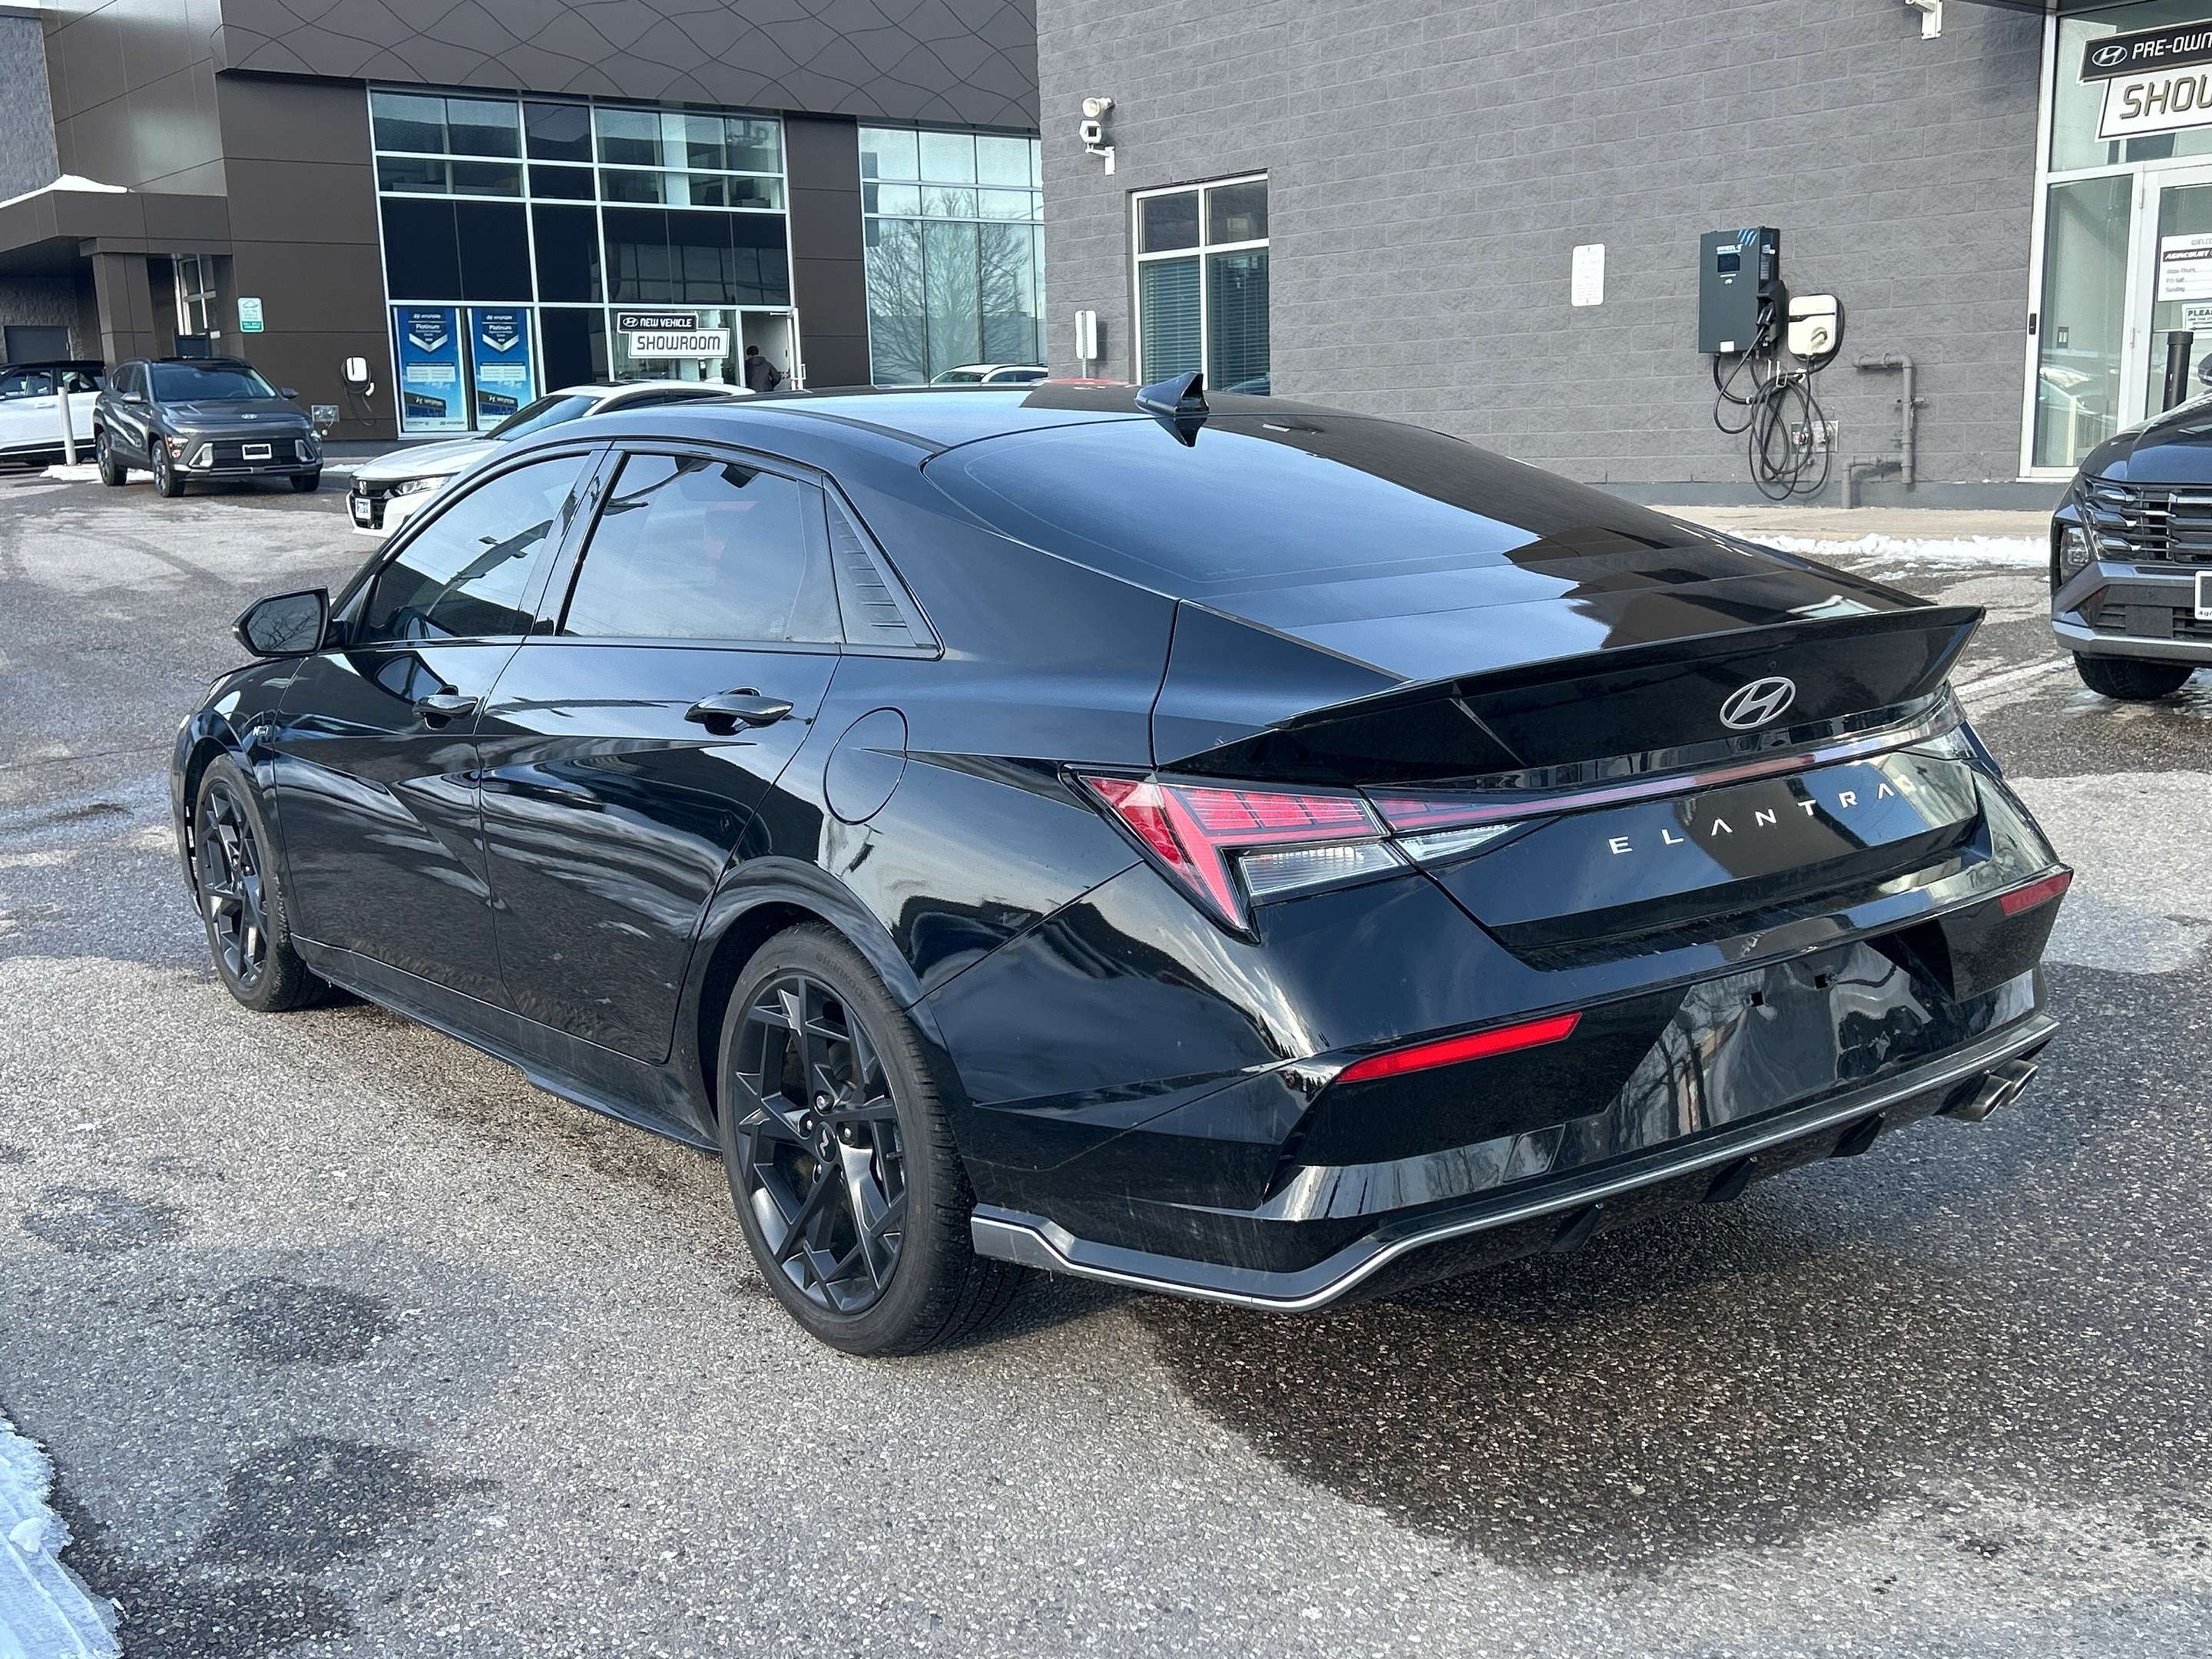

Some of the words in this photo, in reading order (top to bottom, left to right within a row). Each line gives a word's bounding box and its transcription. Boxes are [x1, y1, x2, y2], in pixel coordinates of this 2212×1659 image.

[640, 318, 658, 326] NEW
[660, 318, 693, 327] VEHICLE
[637, 336, 720, 350] SHOWROOM
[1608, 782, 1896, 855] ELANTRA
